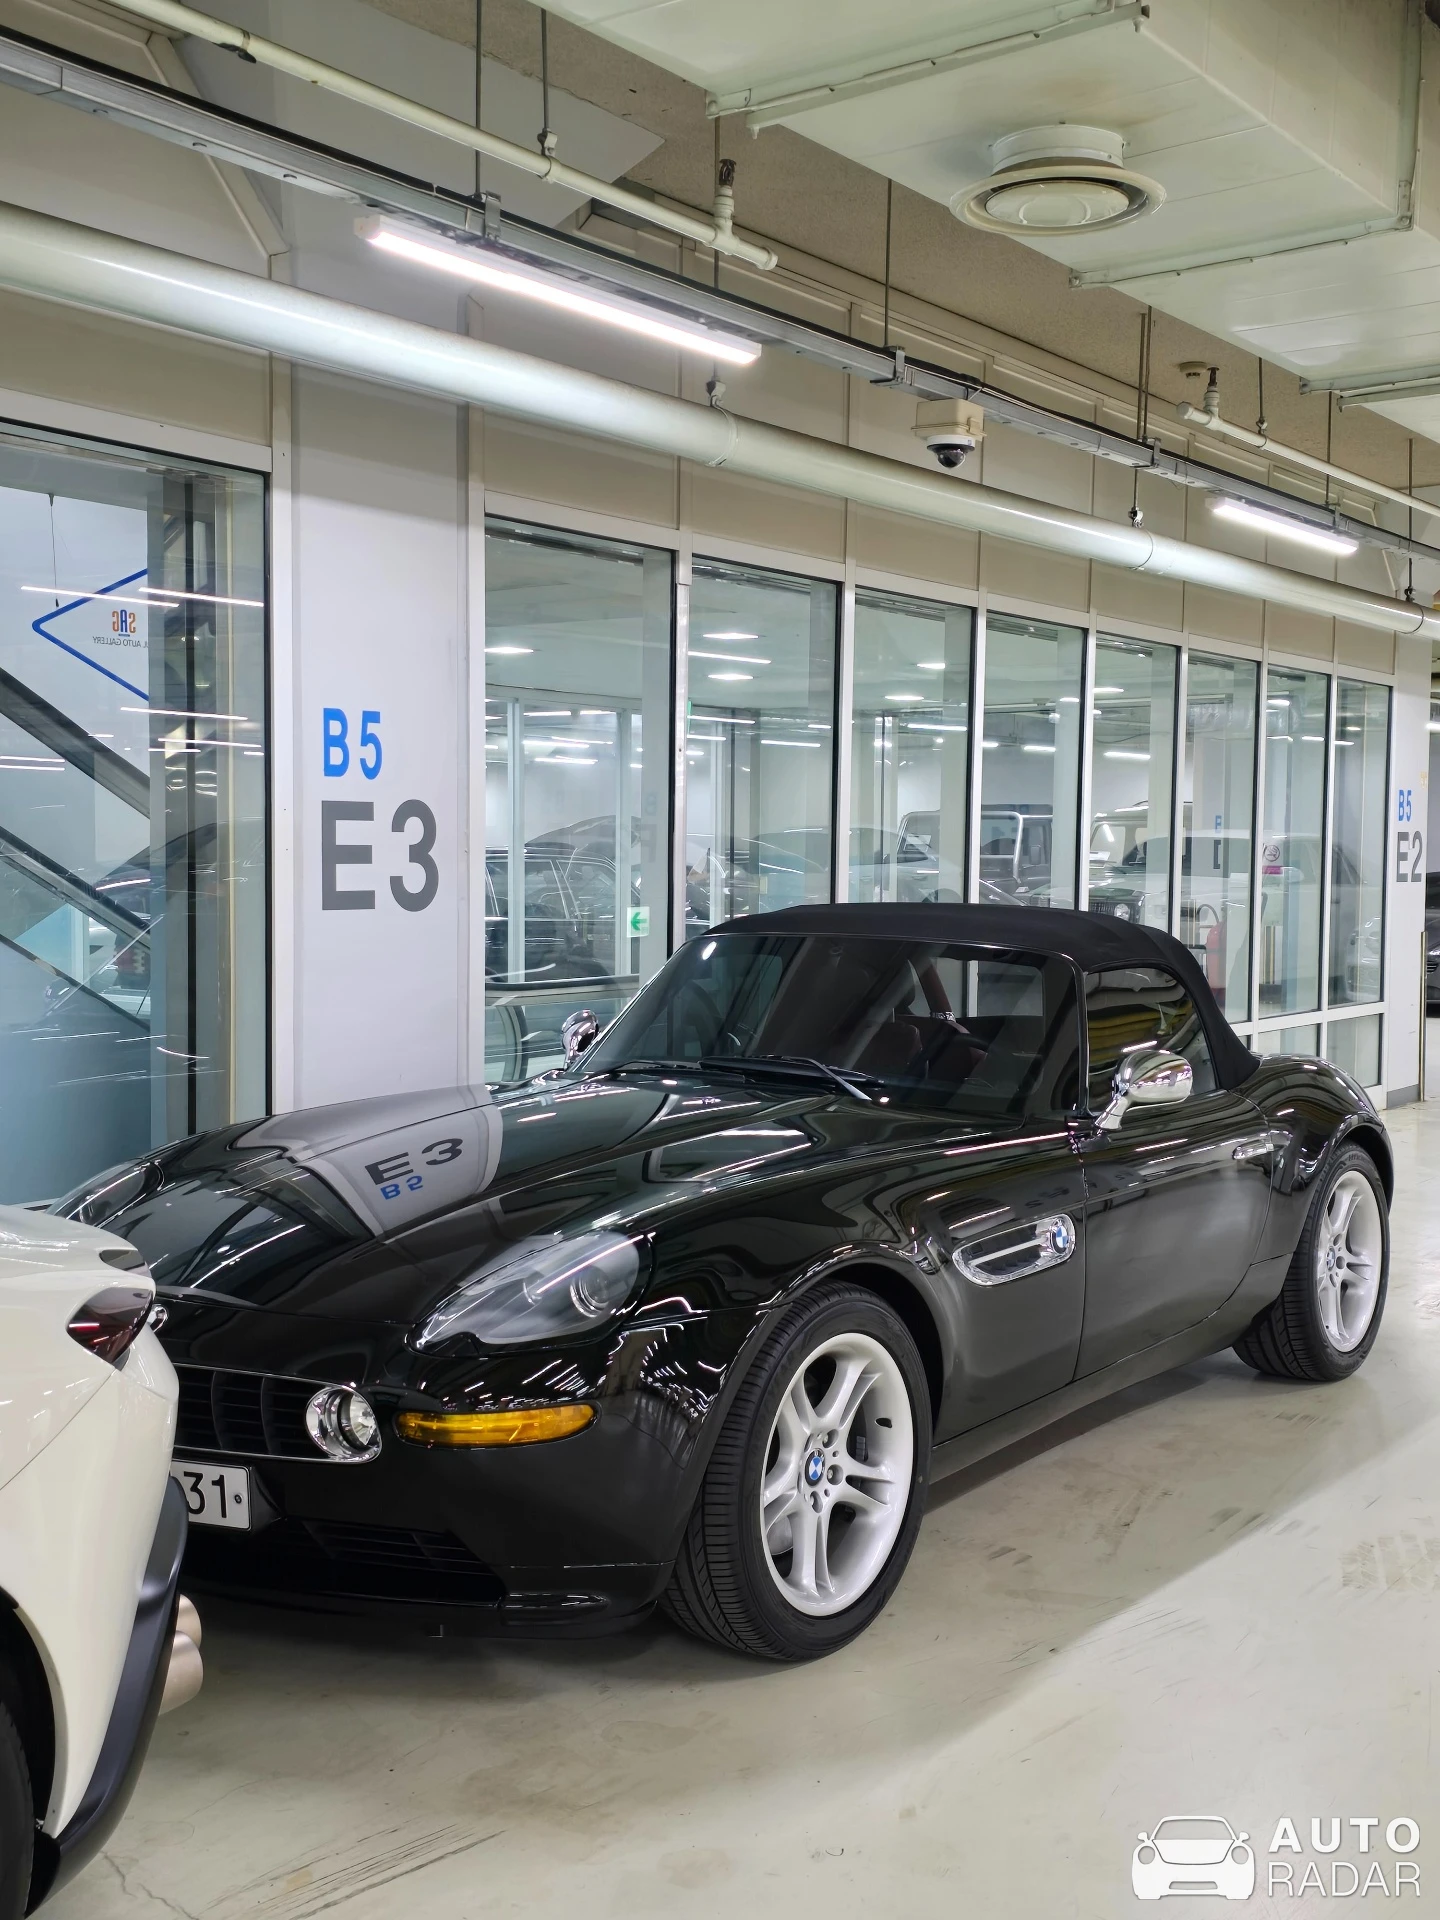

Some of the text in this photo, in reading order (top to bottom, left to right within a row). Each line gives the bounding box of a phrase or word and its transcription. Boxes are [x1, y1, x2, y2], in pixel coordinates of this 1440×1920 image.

[323, 707, 383, 780] B5
[1398, 789, 1412, 822] B5
[321, 798, 439, 912] E3
[1396, 830, 1423, 882] E2
